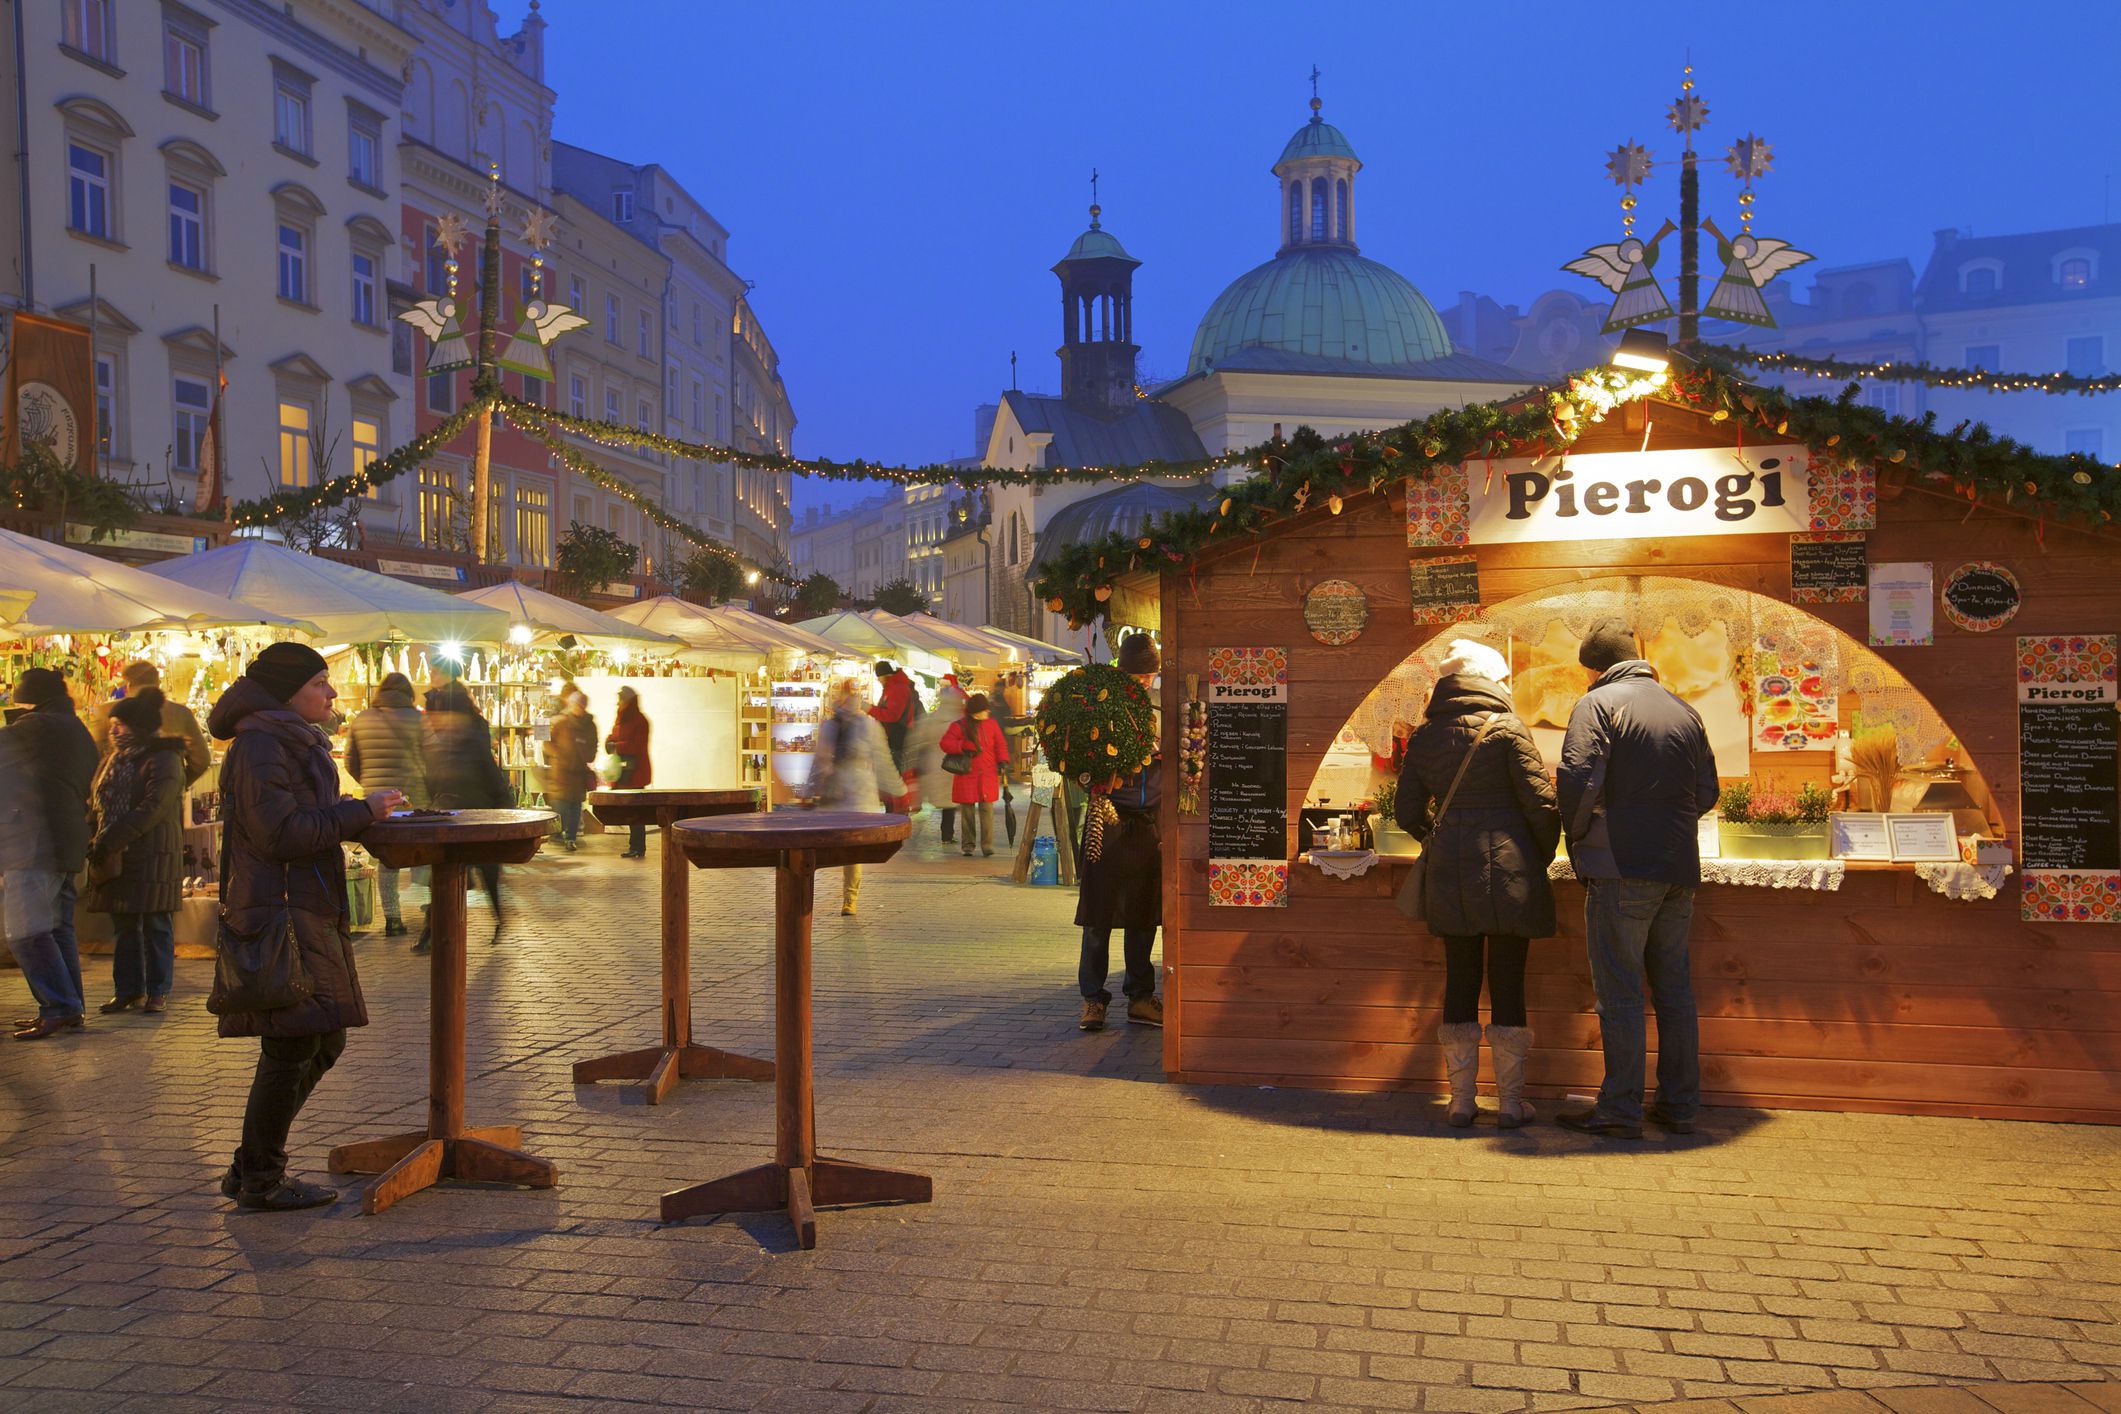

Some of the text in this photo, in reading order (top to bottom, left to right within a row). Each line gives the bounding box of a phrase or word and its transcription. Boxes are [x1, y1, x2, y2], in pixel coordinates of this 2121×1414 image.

[1504, 458, 1786, 522] Pierogi
[1958, 582, 2001, 592] DUMPLINGS
[1216, 686, 1277, 698] Pierogi
[2028, 687, 2104, 700] Pierogi
